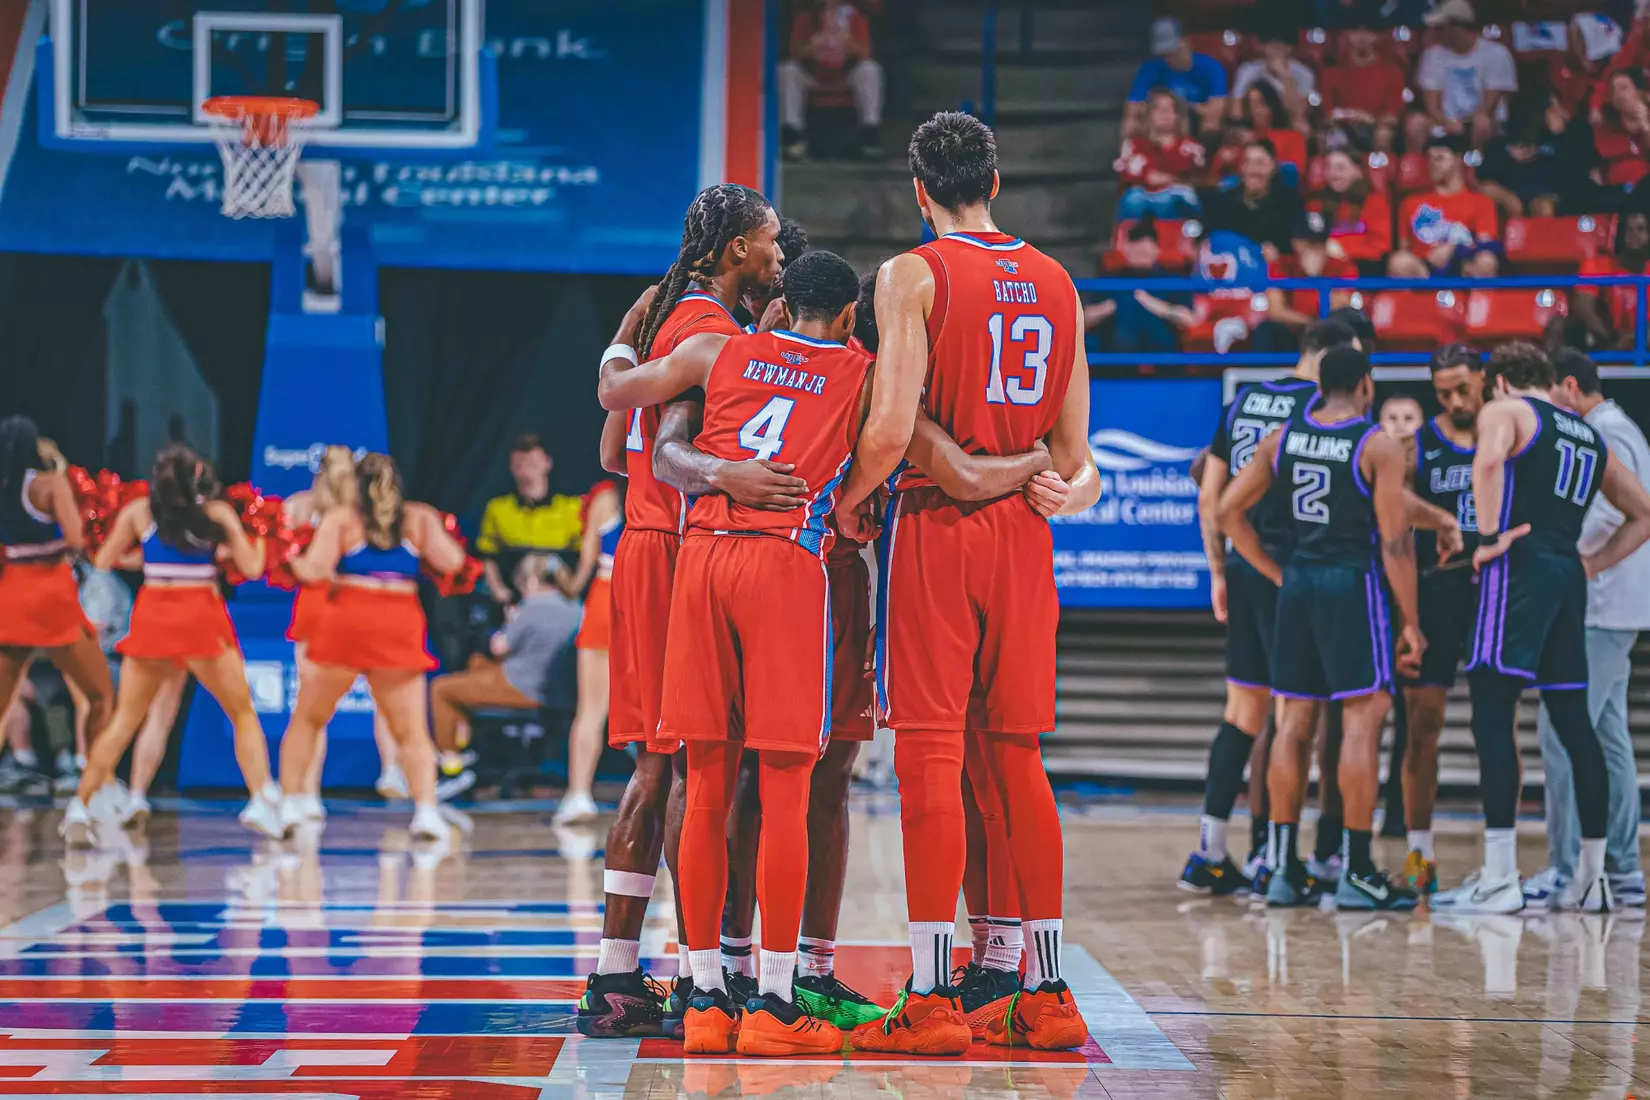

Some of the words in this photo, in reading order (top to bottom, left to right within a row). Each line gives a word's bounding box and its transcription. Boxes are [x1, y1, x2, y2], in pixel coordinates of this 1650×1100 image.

[993, 279, 1038, 304] BATCHO
[985, 311, 1054, 406] 13
[738, 394, 797, 461] 4
[1230, 418, 1281, 477] 2
[1292, 461, 1331, 525] 2
[1553, 438, 1598, 507] 11
[1120, 496, 1195, 525] Center
